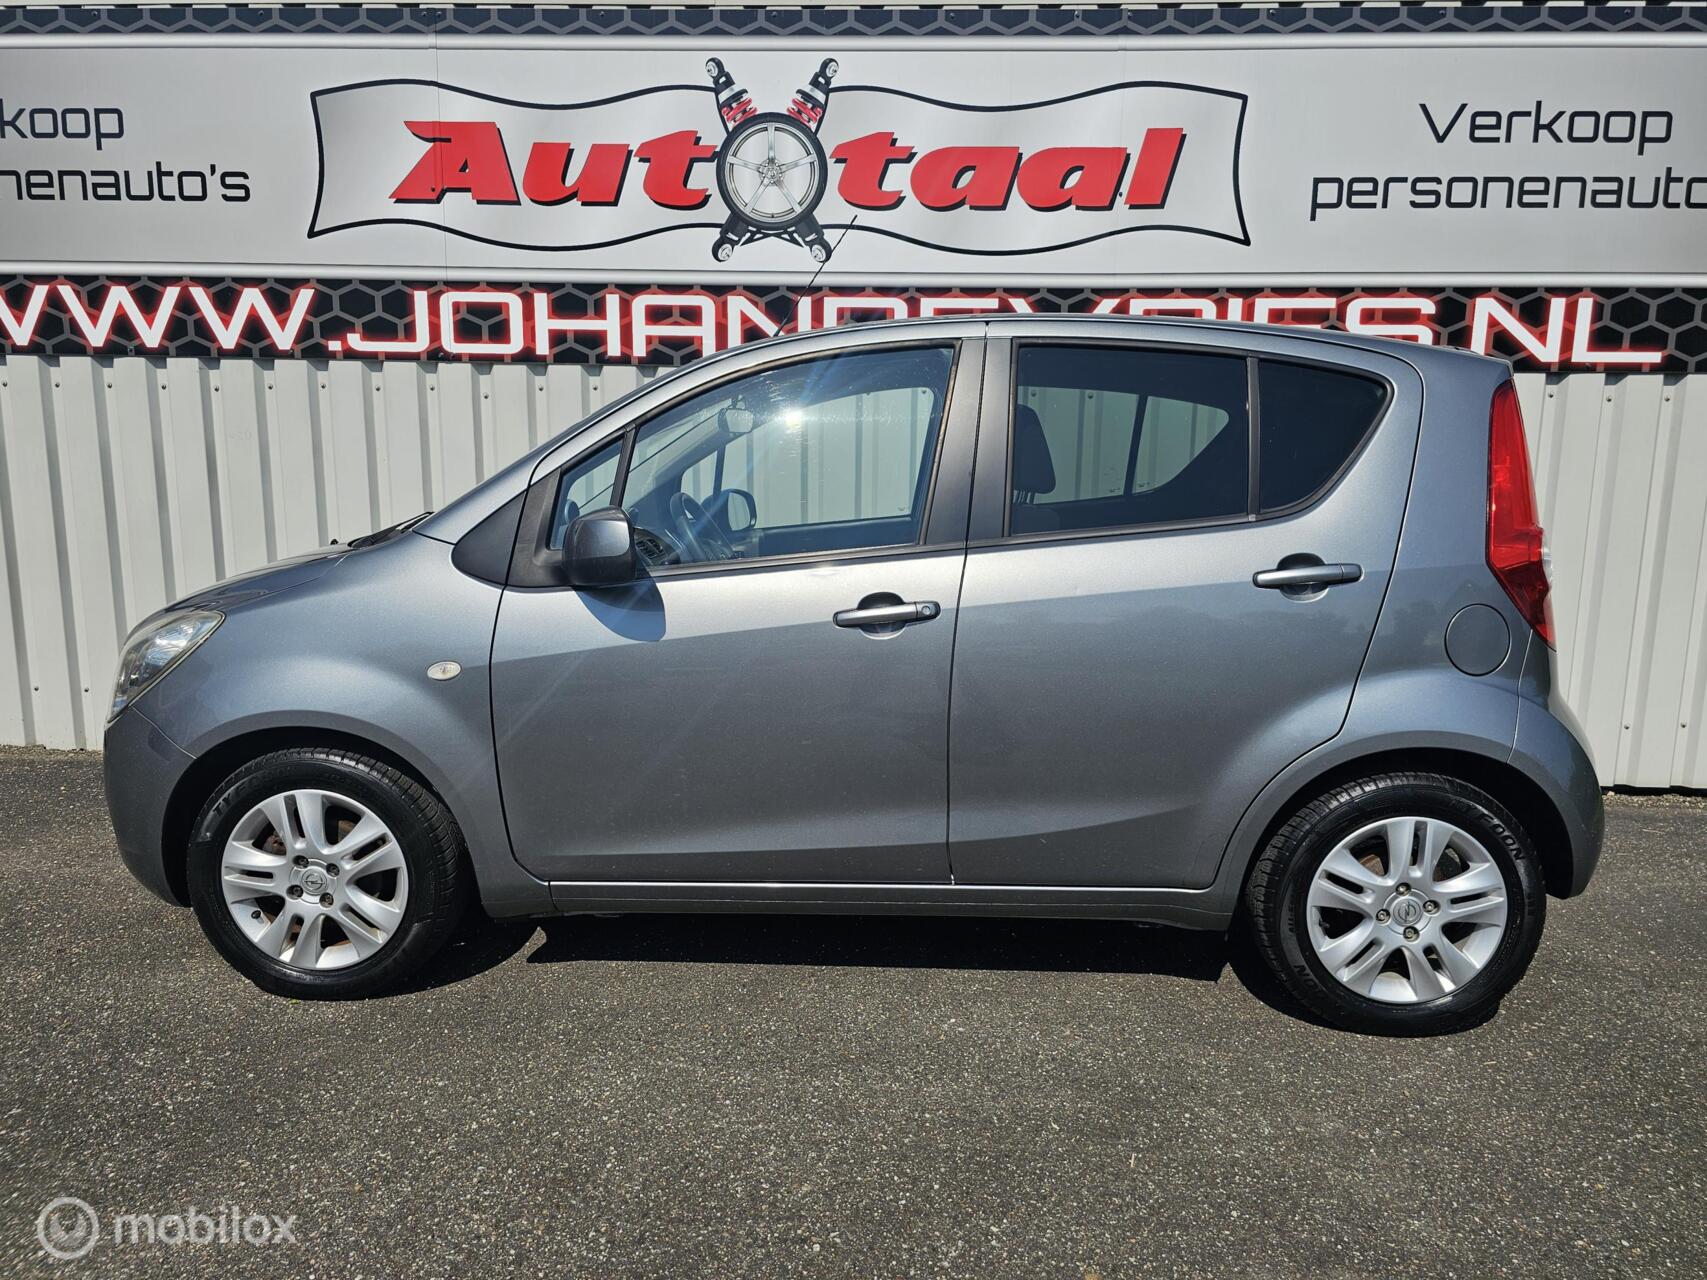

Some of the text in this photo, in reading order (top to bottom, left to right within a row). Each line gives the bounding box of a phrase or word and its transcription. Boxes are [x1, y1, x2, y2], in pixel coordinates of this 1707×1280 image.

[0, 98, 124, 150] koop
[1419, 100, 1673, 155] Verkoop
[1310, 166, 1707, 221] personenauto
